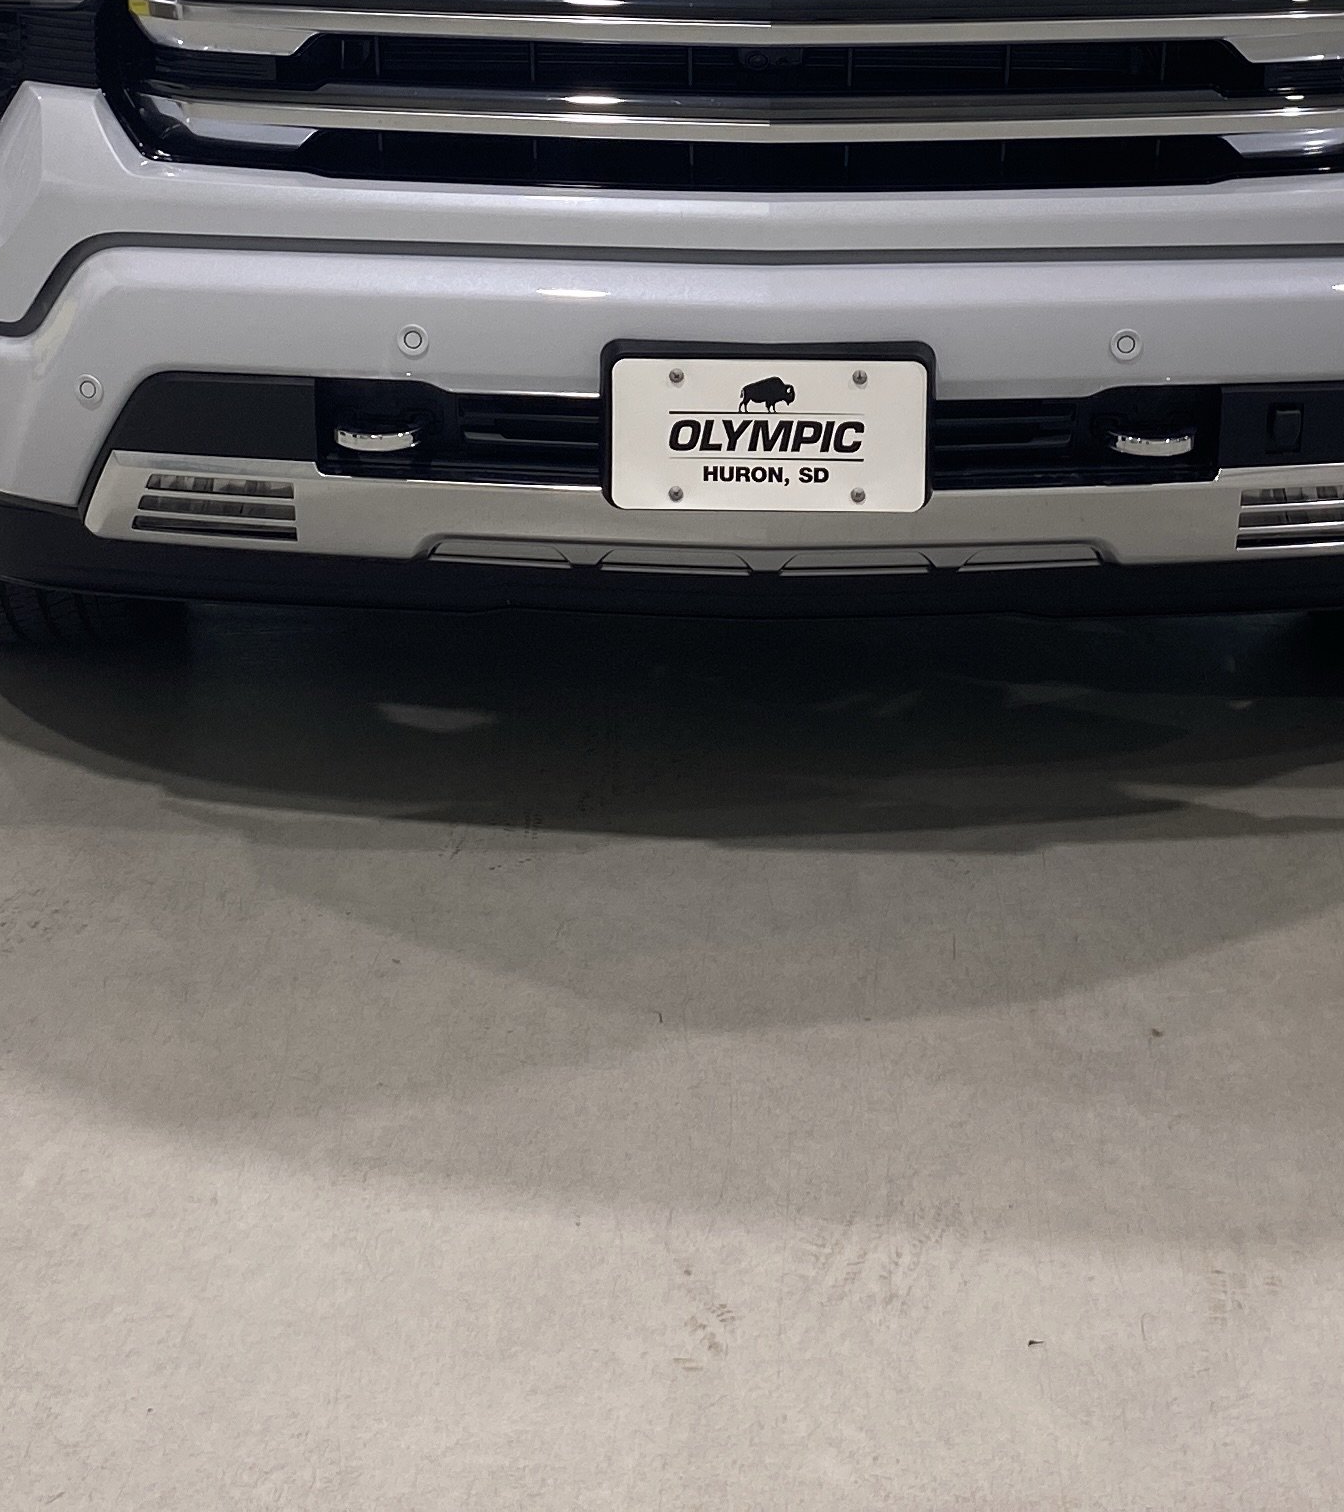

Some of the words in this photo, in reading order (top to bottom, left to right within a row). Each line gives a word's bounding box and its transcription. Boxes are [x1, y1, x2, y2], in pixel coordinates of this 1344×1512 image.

[668, 419, 865, 454] OLYMPIC
[702, 465, 790, 486] HURON,
[798, 467, 830, 484] SD
